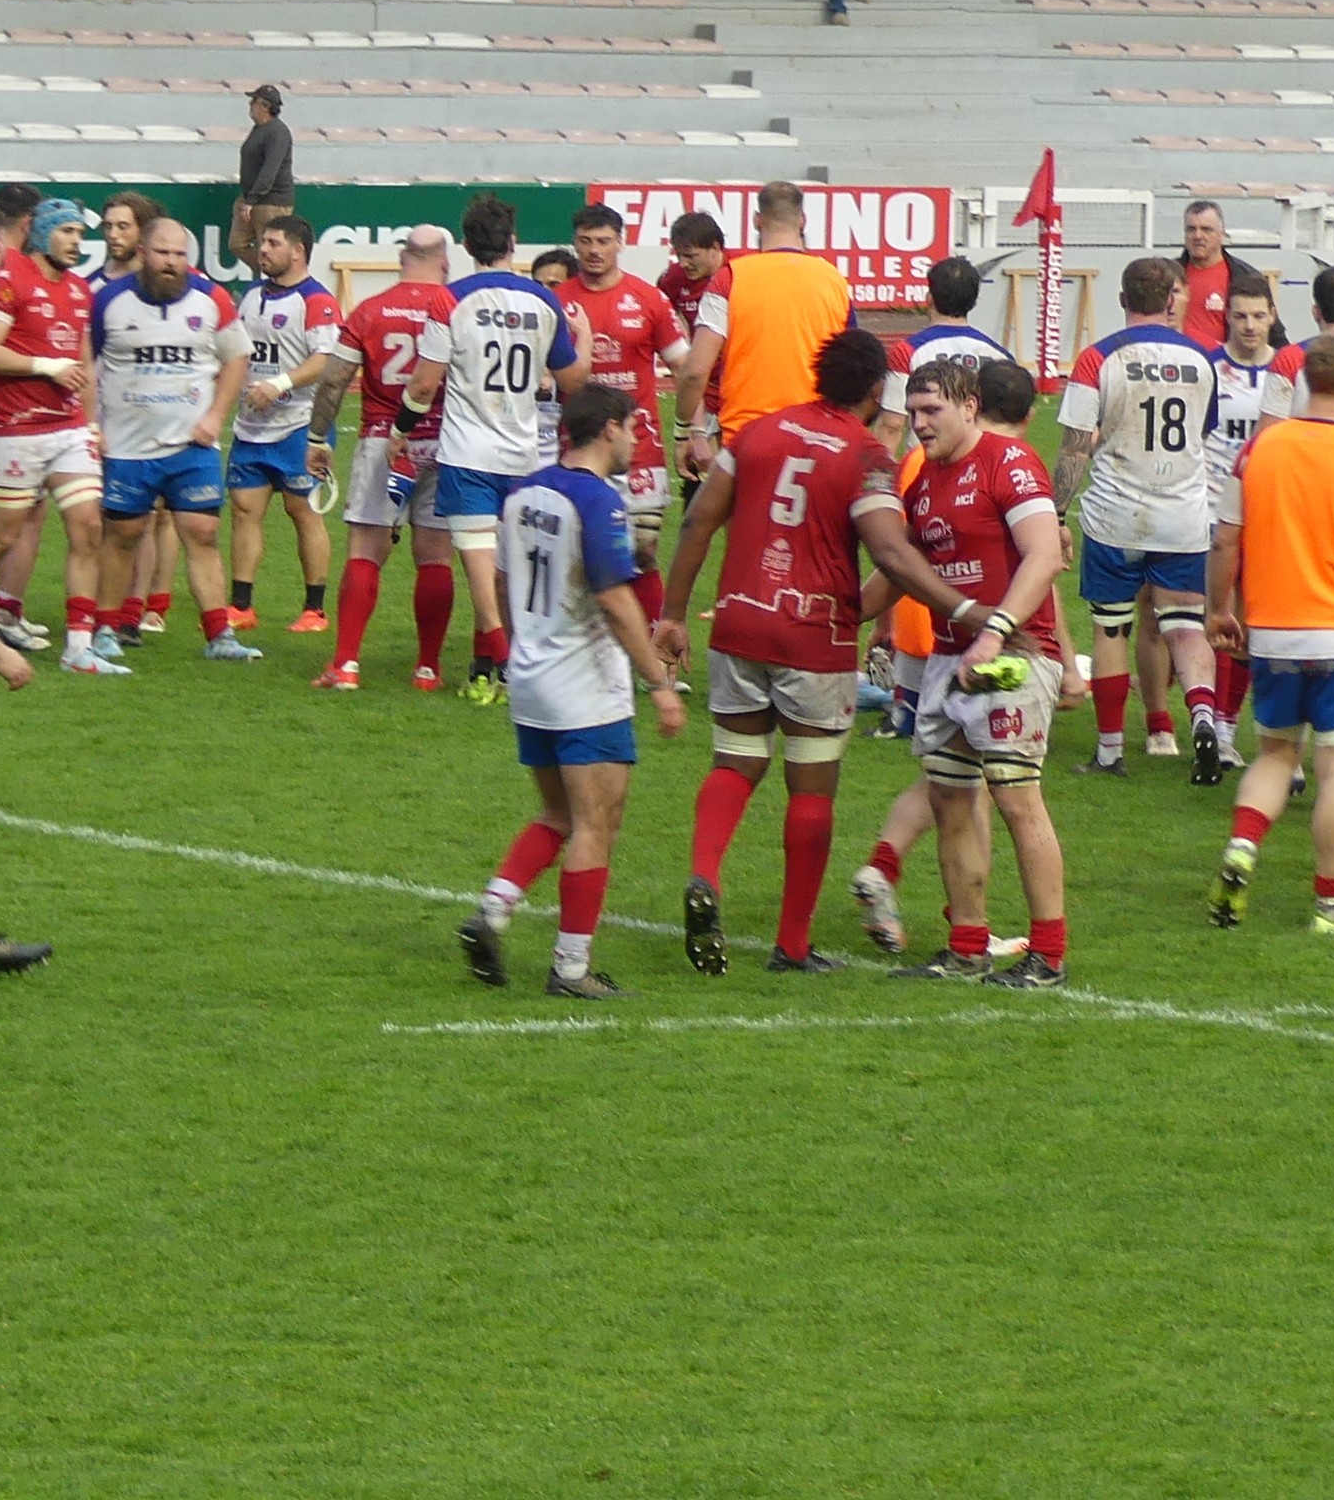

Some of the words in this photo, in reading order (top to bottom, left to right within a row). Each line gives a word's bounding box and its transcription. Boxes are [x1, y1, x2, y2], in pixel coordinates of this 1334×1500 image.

[249, 340, 279, 364] BI
[483, 340, 532, 394] 20
[1125, 362, 1199, 385] SCOB
[1138, 396, 1187, 452] 18
[770, 456, 816, 527] 5
